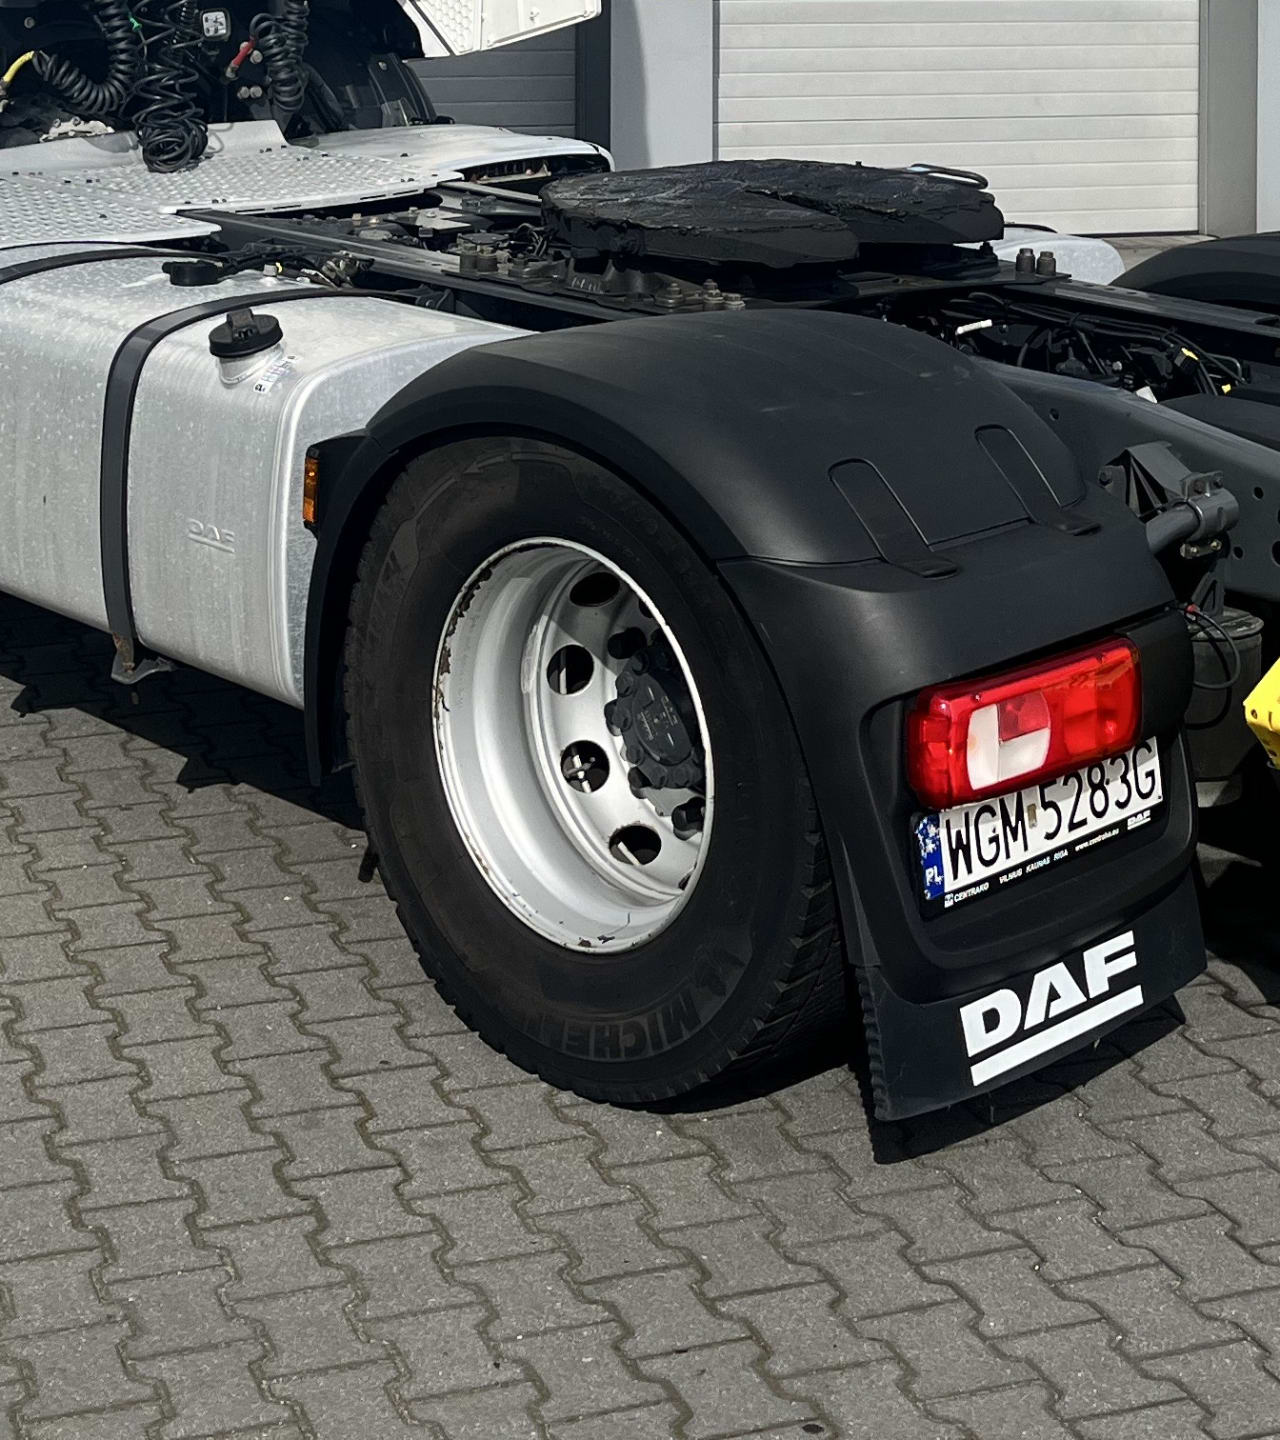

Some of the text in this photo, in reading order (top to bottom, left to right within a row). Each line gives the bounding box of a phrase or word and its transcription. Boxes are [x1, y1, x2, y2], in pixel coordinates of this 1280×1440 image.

[945, 742, 1156, 882] WGM 5283G
[925, 865, 943, 887] PL
[526, 988, 704, 1064] MICHE
[959, 930, 1138, 1057] DAF
